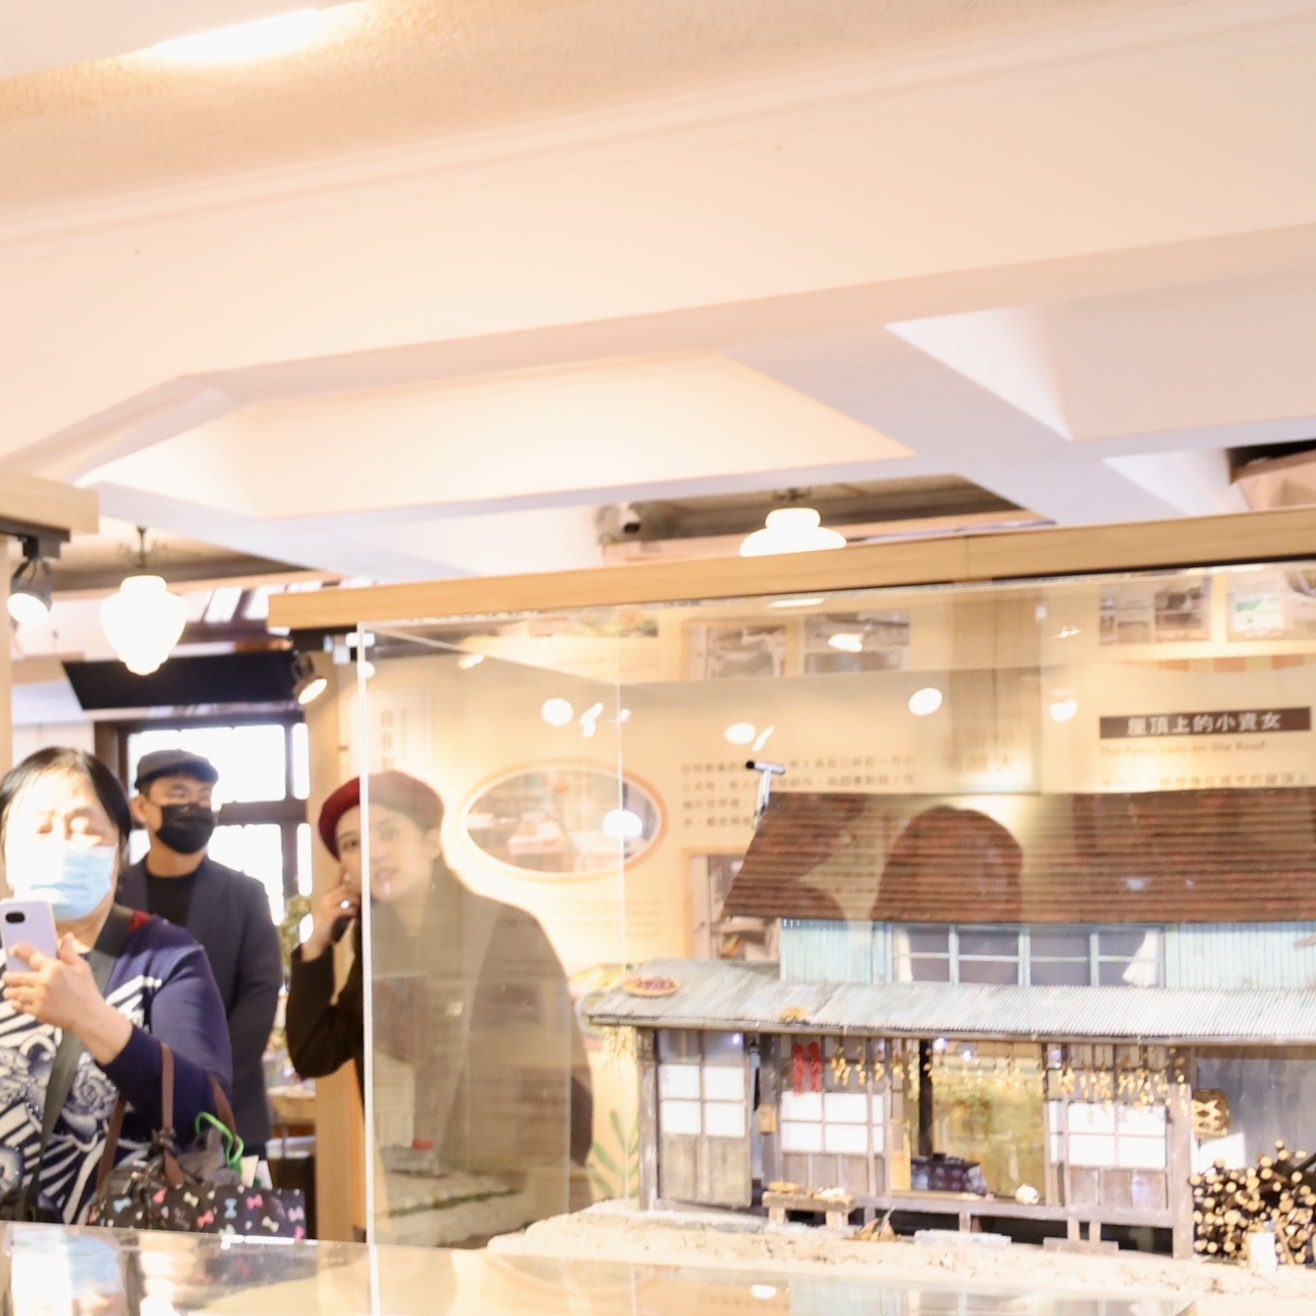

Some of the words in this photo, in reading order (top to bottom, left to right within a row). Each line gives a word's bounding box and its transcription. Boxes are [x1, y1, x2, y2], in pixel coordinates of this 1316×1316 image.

[1127, 711, 1282, 736] 屋頂上的小資女
